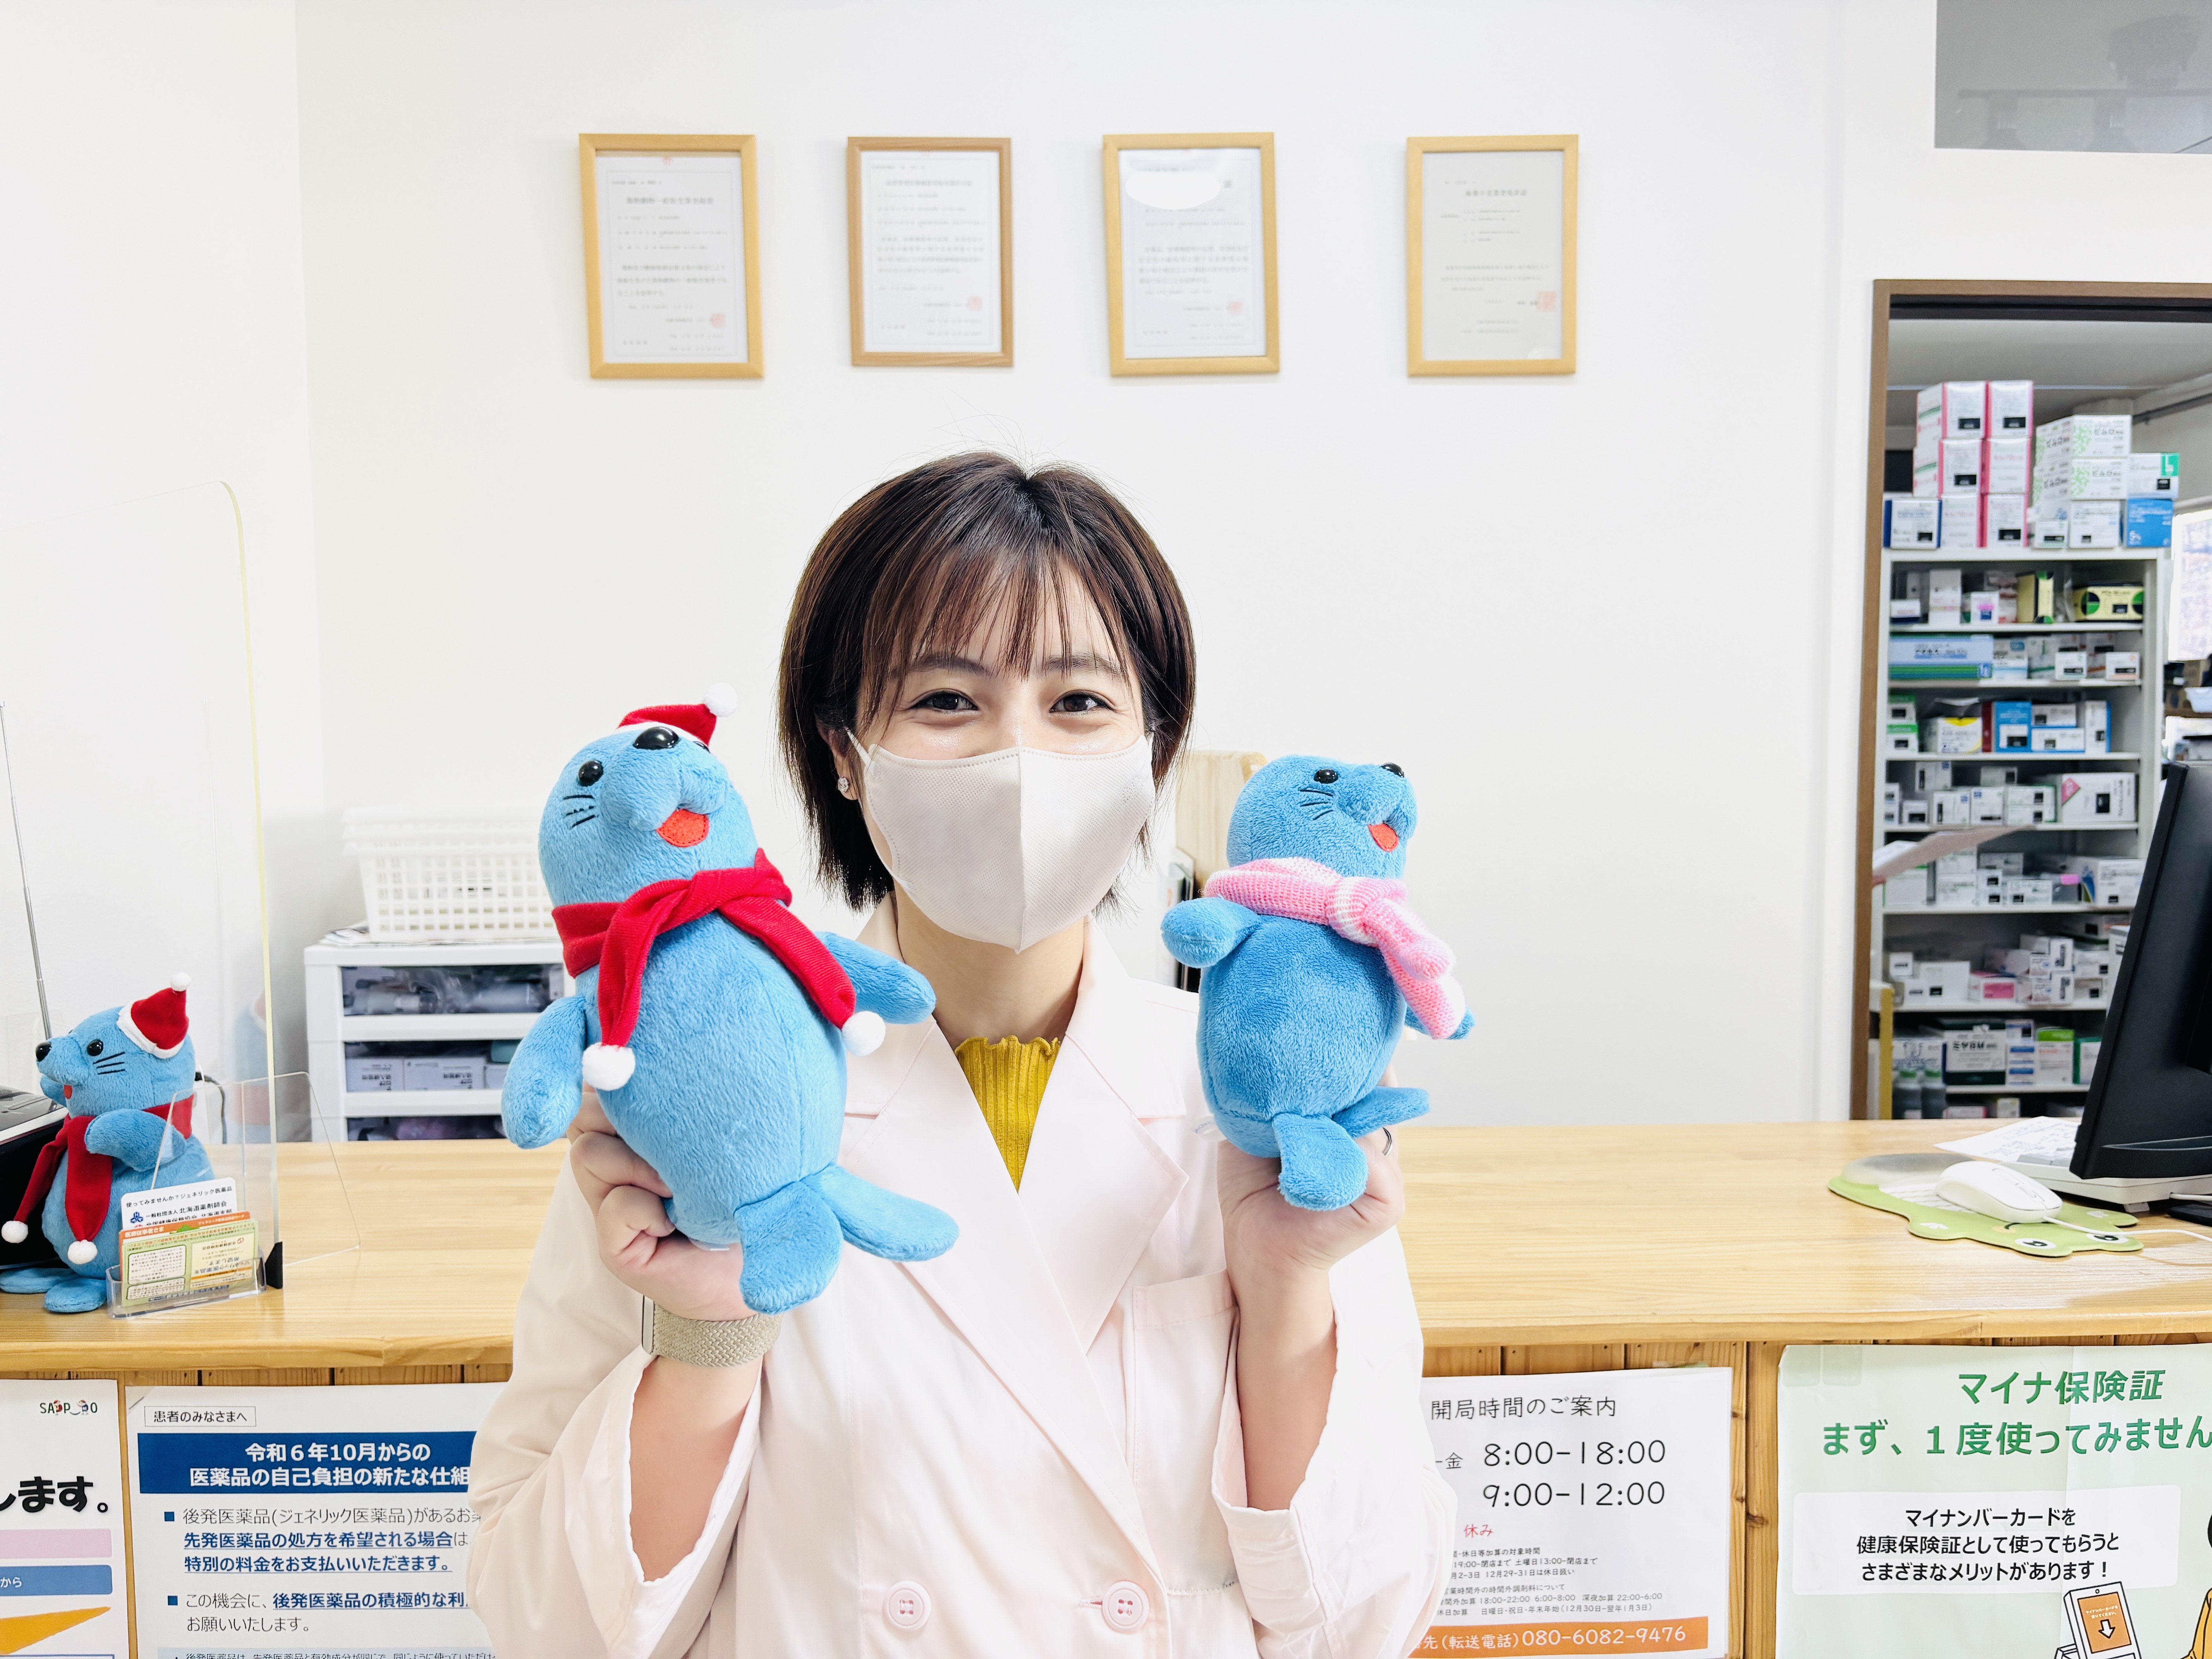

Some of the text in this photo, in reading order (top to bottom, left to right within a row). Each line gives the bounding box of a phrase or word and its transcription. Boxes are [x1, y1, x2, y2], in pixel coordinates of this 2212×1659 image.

[1958, 1369, 2166, 1406] マイナ保険証
[154, 1410, 248, 1423] 患者のみなさまへ
[1431, 1395, 1616, 1420] 開局時間のご案内
[245, 1443, 431, 1462] 令和６年10月からの
[1484, 1439, 1666, 1467] 8:00-18:00
[190, 1466, 470, 1487] 医薬品の自己負担の新たな仕組
[1482, 1481, 1666, 1508] 9:00-12:00
[1905, 1507, 2076, 1528] マイナンバーカードを
[184, 1532, 469, 1549] 先発医薬品の処方を希望される場合は
[1463, 1523, 1494, 1539] 休み
[1856, 1532, 2119, 1556] 健康保険証として使ってもらうと
[184, 1555, 448, 1572] 特別の料金をお支払いいただきます。
[1862, 1560, 2109, 1582] さまざまなメリットがあります！
[0, 1577, 22, 1588] から
[187, 1592, 468, 1609] この機会に、後発医薬品の積極的な利
[187, 1616, 309, 1633] お願いいたします。
